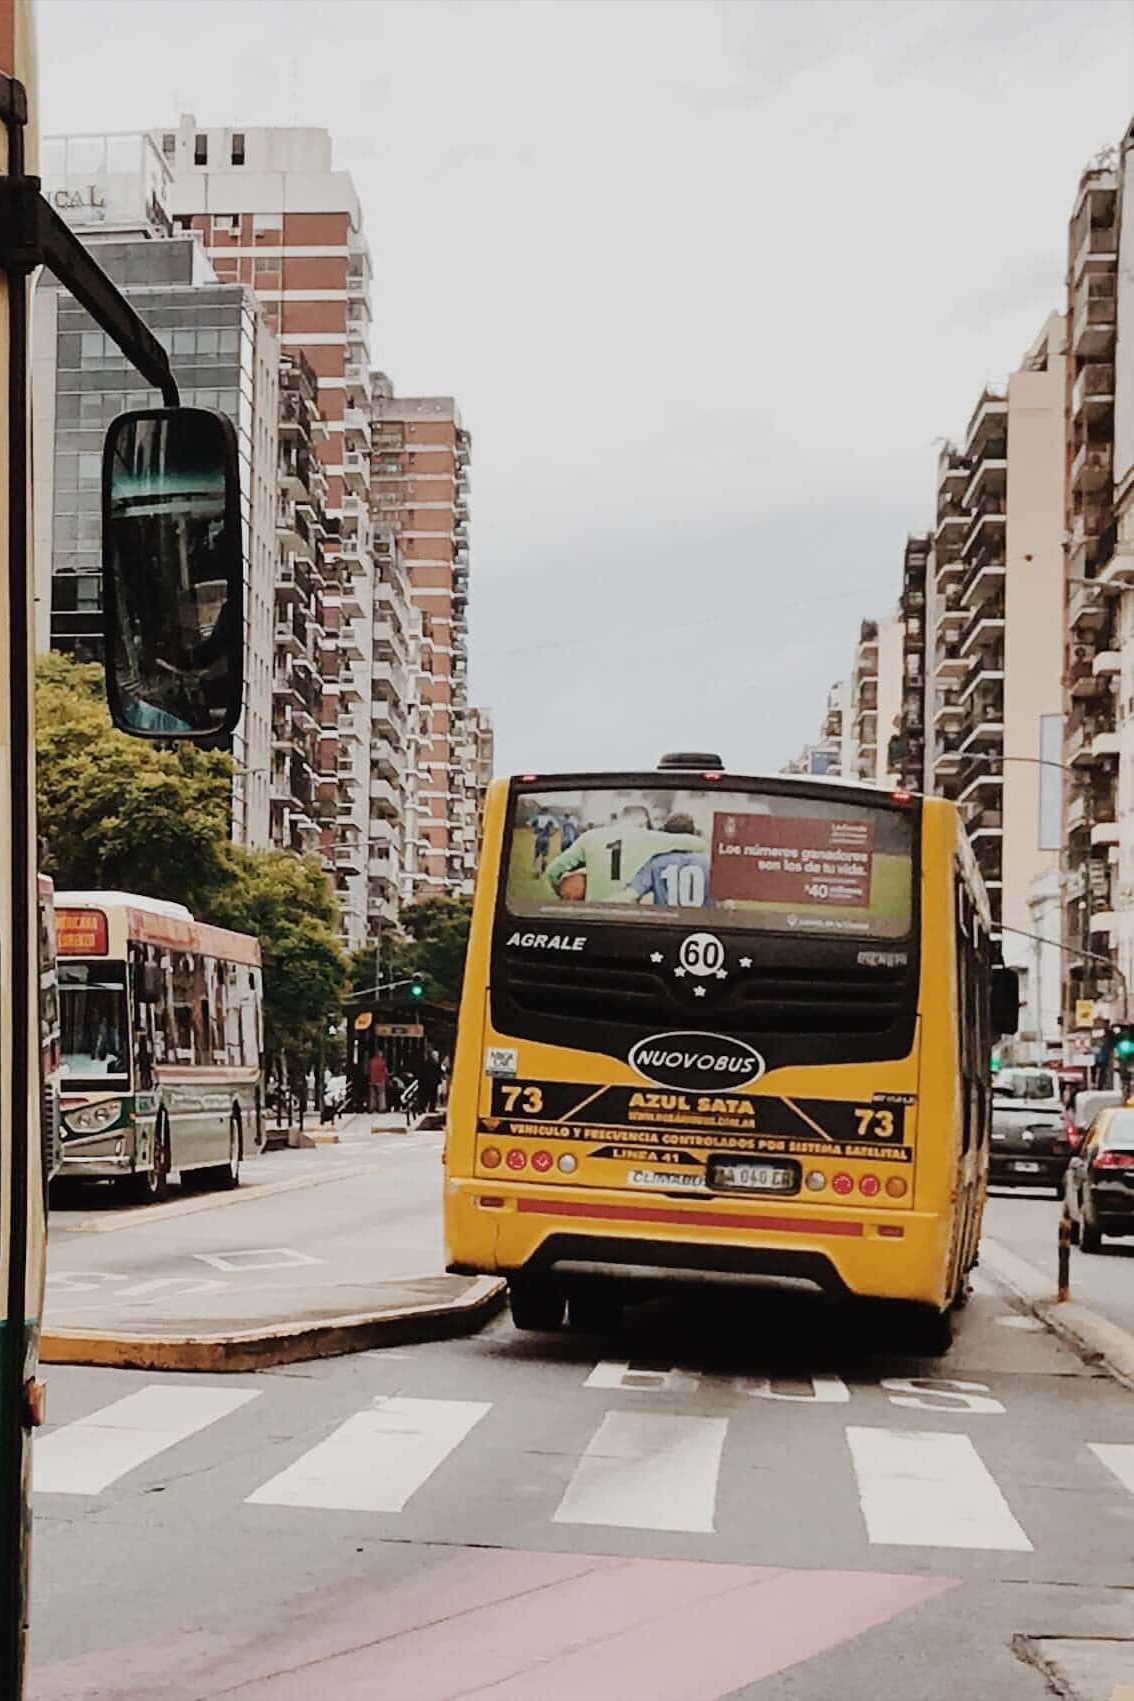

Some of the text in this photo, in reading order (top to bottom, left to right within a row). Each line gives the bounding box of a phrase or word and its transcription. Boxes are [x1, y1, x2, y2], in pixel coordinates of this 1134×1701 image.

[606, 839, 622, 881] 1
[718, 842, 741, 856] Los
[758, 860, 781, 871] son
[783, 859, 802, 872] los
[804, 861, 821, 874] de
[661, 864, 705, 908] 10
[506, 932, 587, 951] AGRALE
[684, 940, 720, 969] 60
[636, 1050, 756, 1074] NUOVOBUS
[500, 1085, 544, 1114] 73
[628, 1092, 755, 1115] AZUL SATA
[853, 1107, 894, 1137] 73
[573, 1126, 582, 1138] Y
[584, 1128, 658, 1144] FRECUENCIA
[661, 1133, 755, 1150] CONTROLADOS
[758, 1139, 785, 1151] POR
[789, 1141, 842, 1155] SISTEMA
[845, 1145, 908, 1161] SATELITAL
[613, 1148, 680, 1163] LINEA 41
